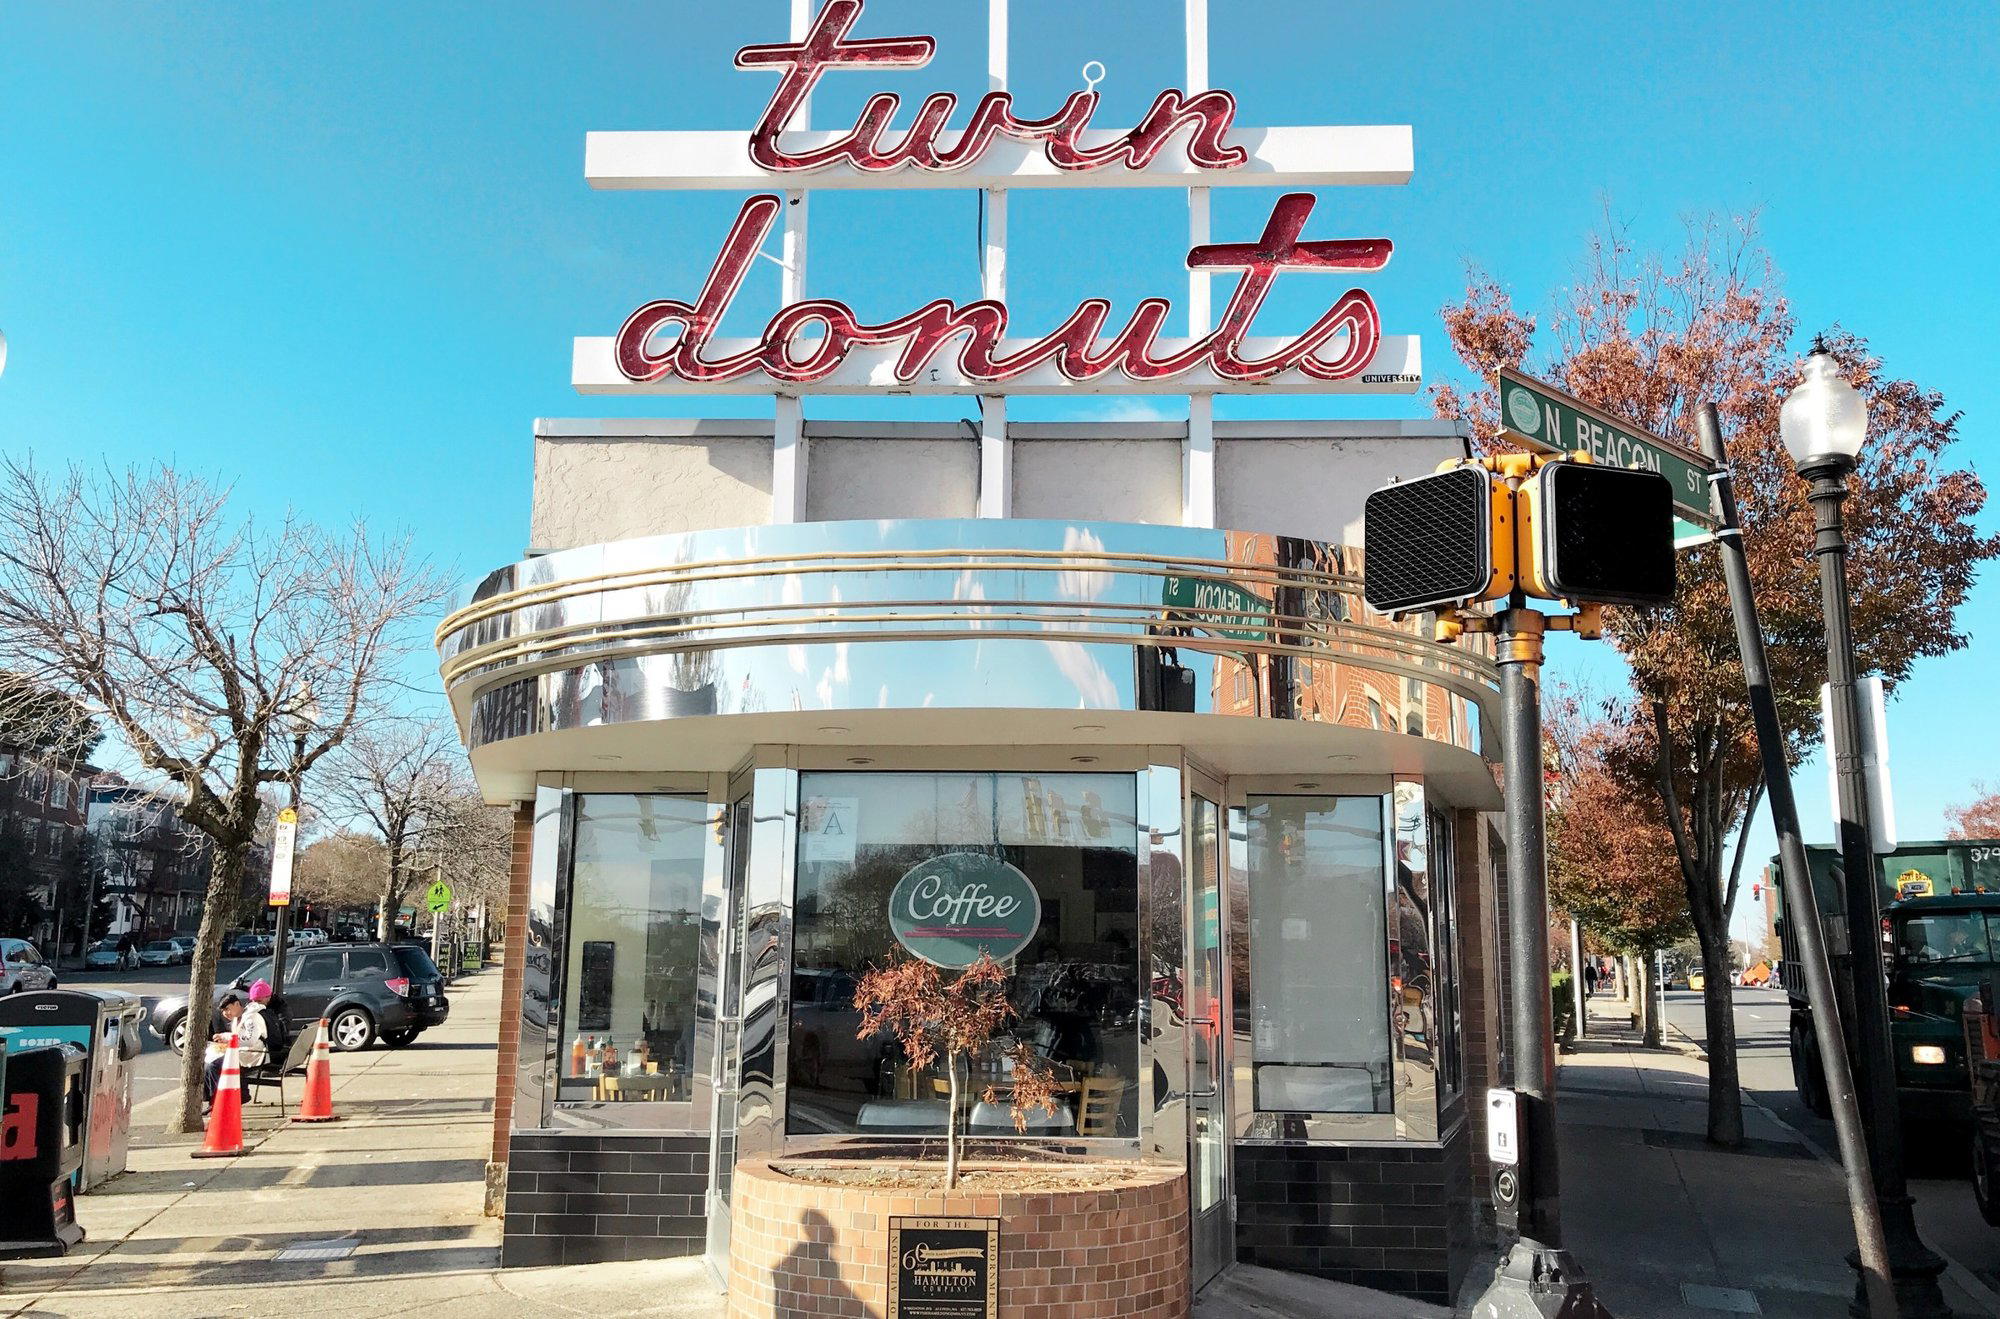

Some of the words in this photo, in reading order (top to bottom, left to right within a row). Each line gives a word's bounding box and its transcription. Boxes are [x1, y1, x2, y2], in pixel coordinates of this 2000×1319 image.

[734, 0, 1247, 173] twin
[613, 193, 1394, 382] donuts
[1365, 375, 1418, 383] UNIVERSITY
[1545, 403, 1567, 448] N.
[1576, 416, 1661, 473] BEACON
[1687, 468, 1701, 494] ST
[822, 811, 846, 835] A
[908, 875, 1021, 925] Coffee
[902, 1242, 929, 1270] 60
[914, 1275, 976, 1287] HAMILTON
[922, 1285, 968, 1293] COMPANY
